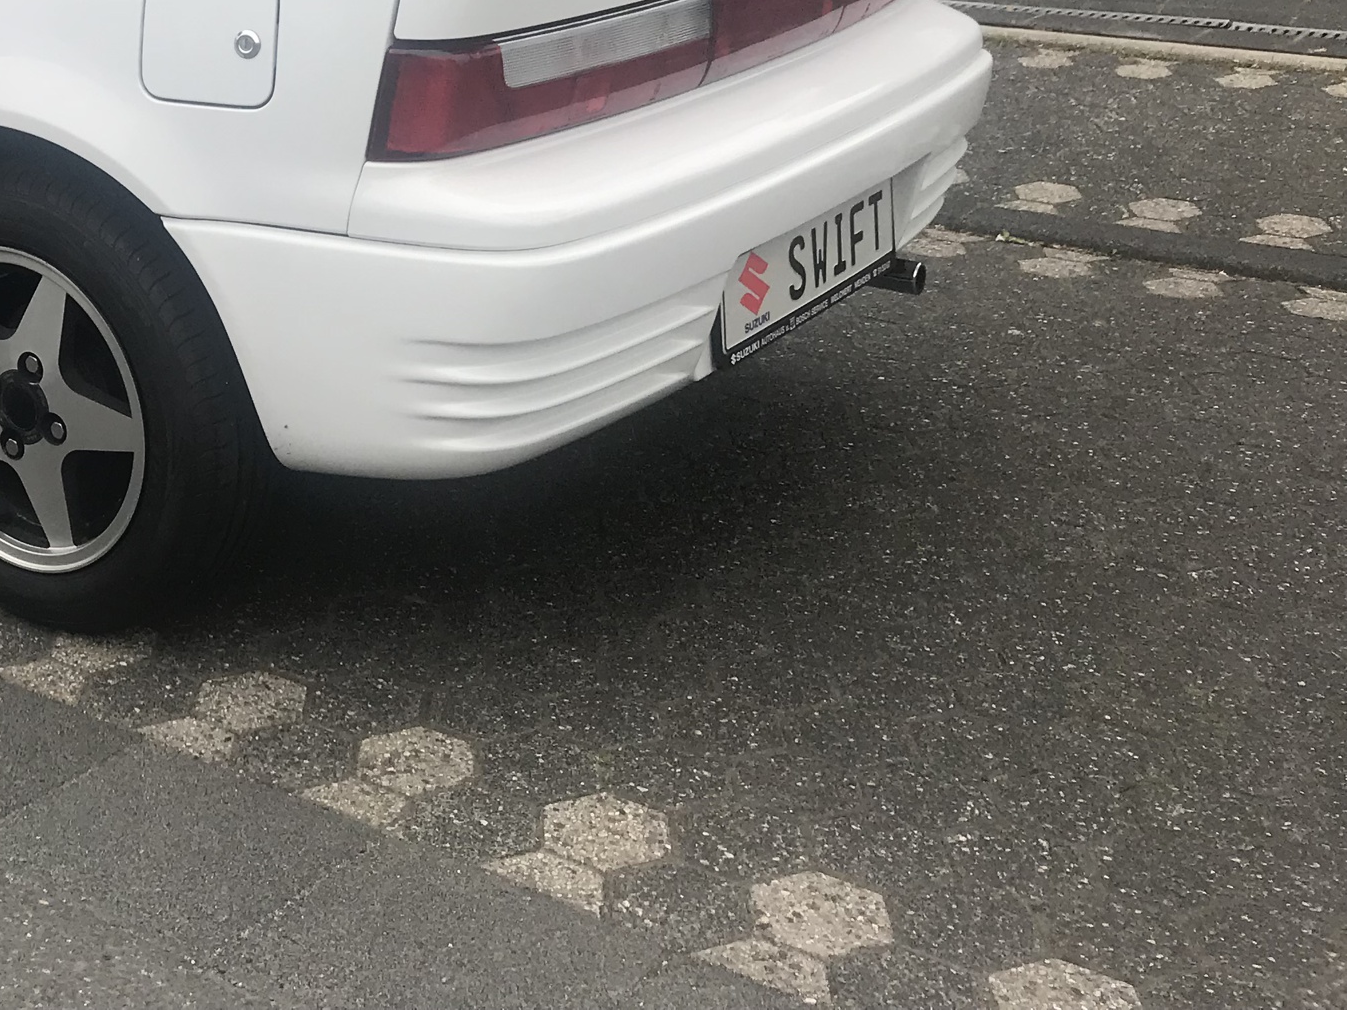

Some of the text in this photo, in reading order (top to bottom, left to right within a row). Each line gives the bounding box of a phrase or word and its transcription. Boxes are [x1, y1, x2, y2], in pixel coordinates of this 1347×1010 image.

[788, 189, 883, 301] SWIFT
[744, 310, 771, 334] SUZUKI
[735, 340, 760, 362] SUZUKI
